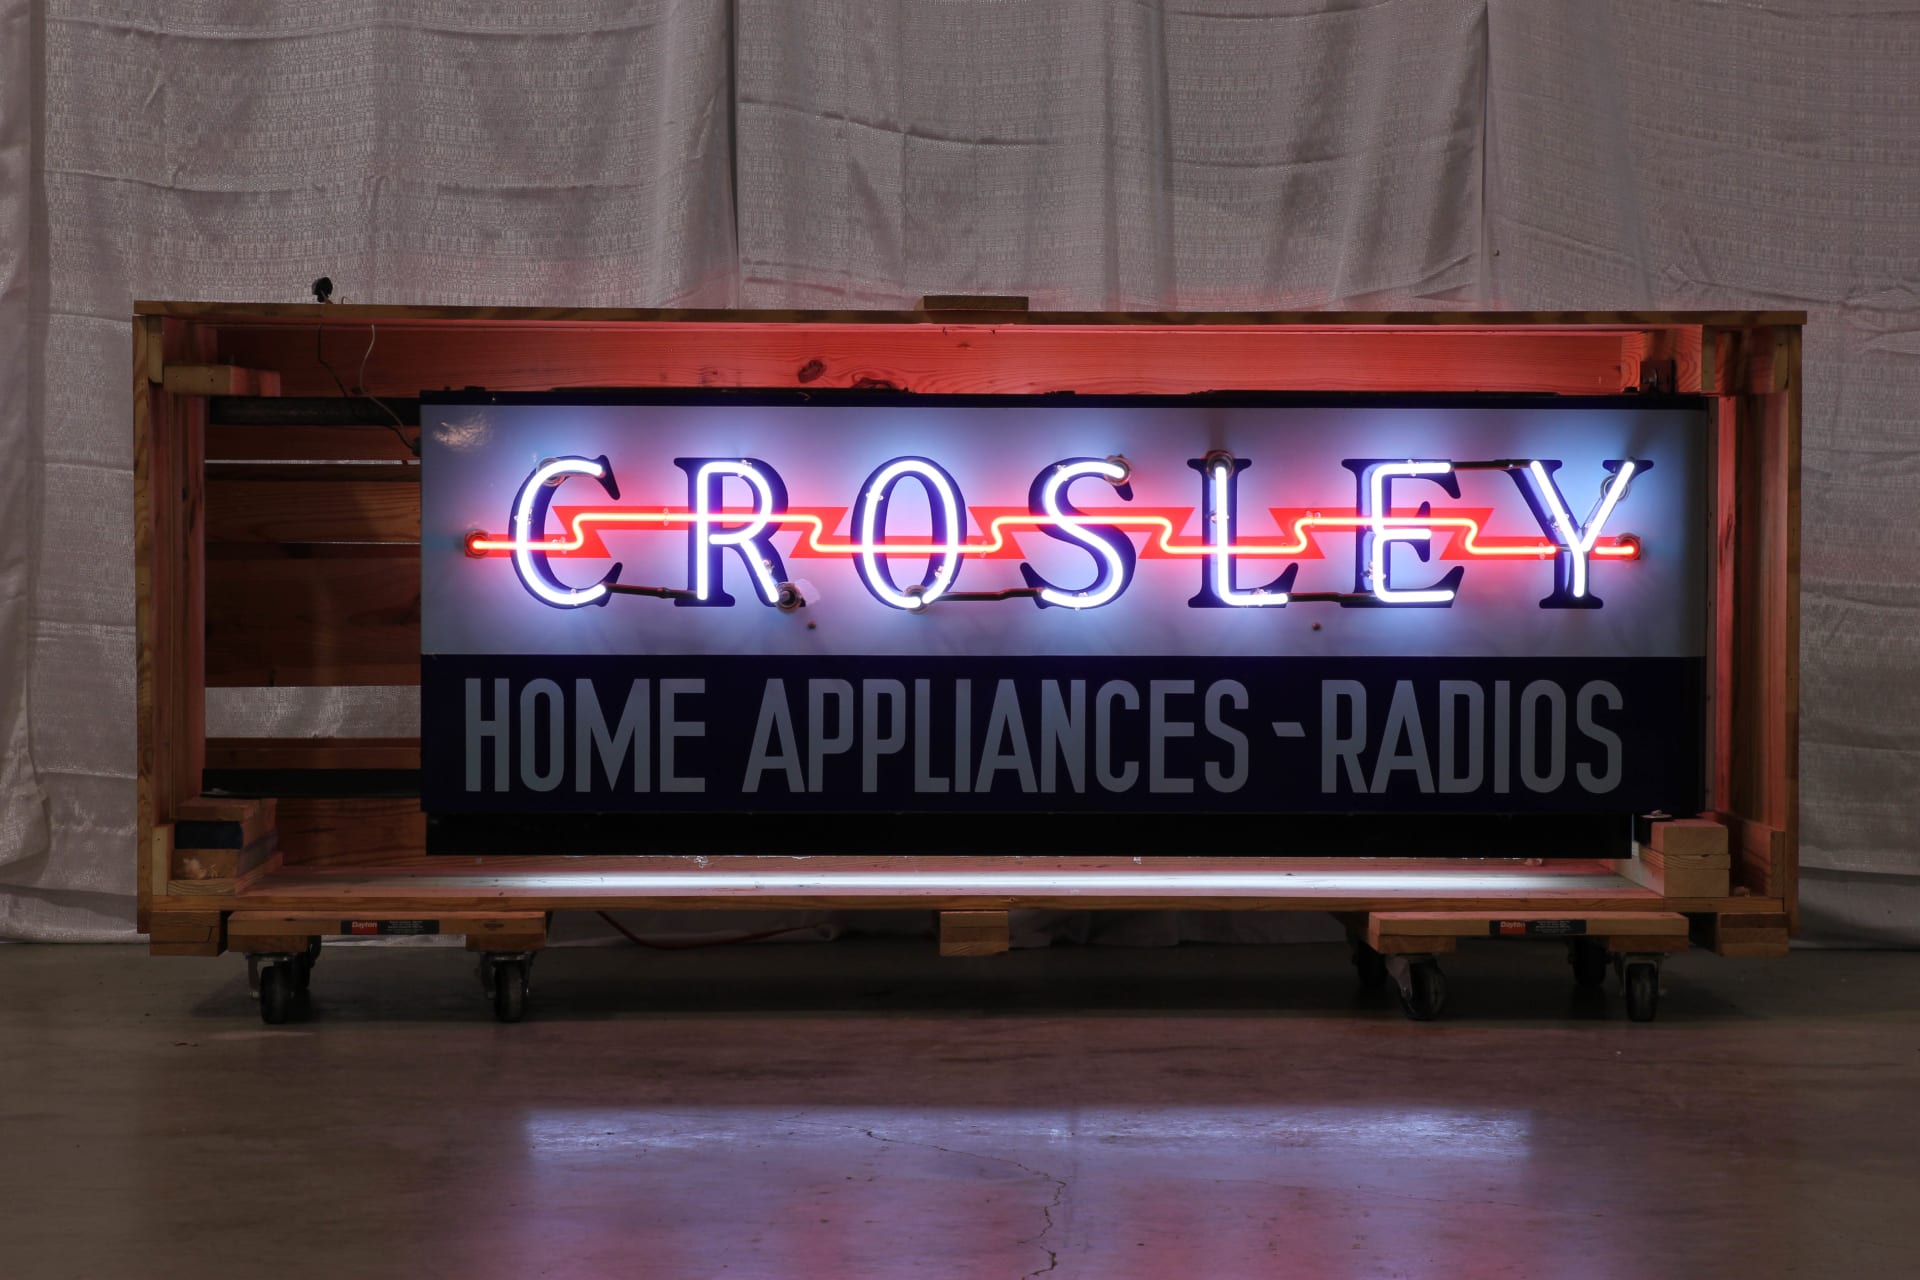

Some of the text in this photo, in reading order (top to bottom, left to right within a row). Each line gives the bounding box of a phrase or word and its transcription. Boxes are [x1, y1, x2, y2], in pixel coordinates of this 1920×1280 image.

[508, 454, 1654, 609] CROSLEY
[465, 677, 706, 793] HOME
[741, 677, 1250, 795] APPLIANCES
[1321, 678, 1624, 795] RADIOS
[351, 920, 378, 930] Dayton
